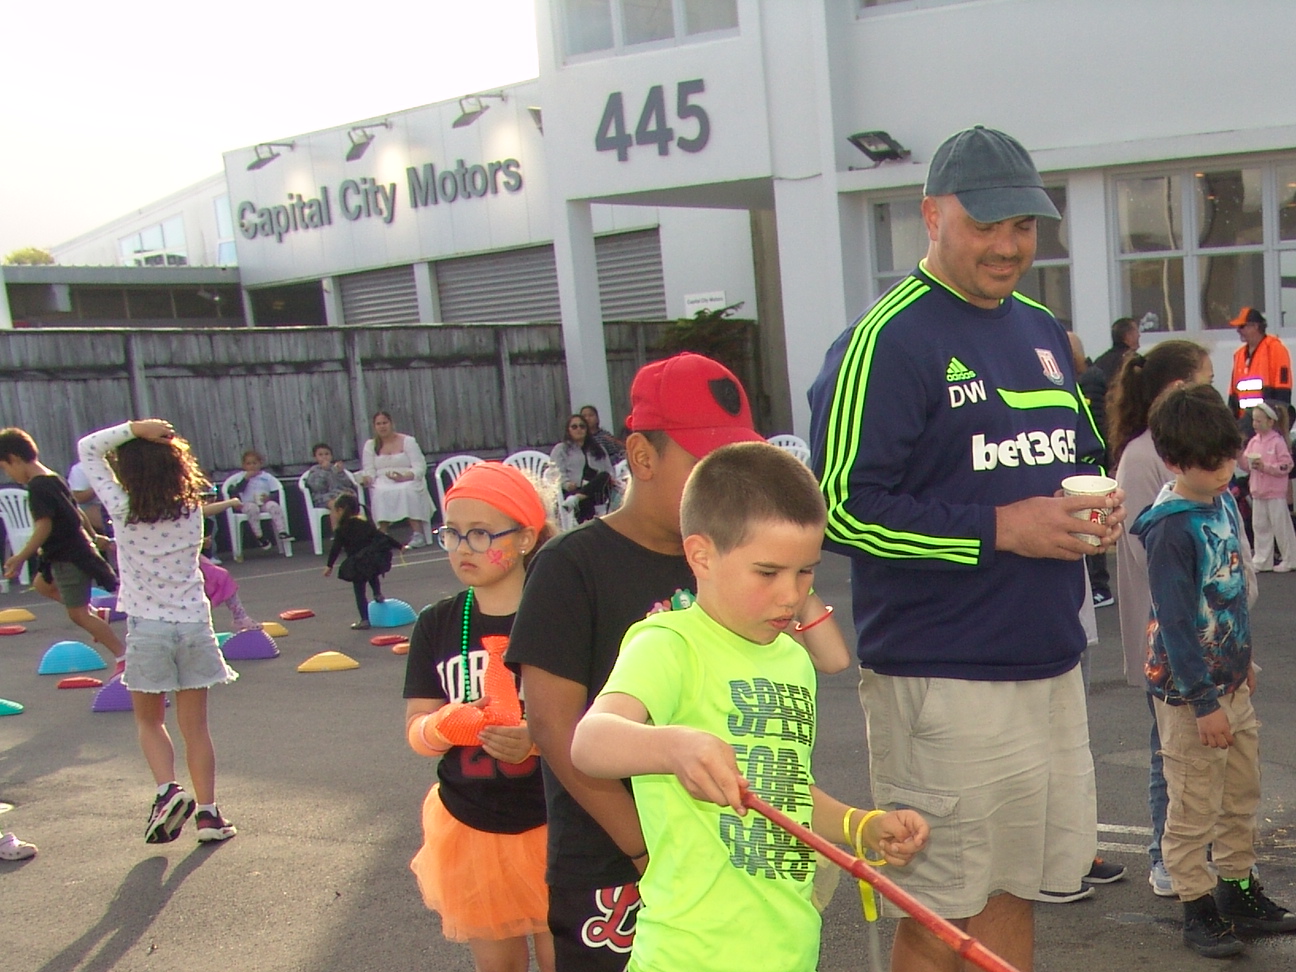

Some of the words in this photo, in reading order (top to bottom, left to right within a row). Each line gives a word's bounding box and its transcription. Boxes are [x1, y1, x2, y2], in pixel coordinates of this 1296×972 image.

[594, 78, 711, 162] 445
[236, 186, 332, 242] Capital
[337, 177, 397, 224] City
[406, 157, 523, 208] Motors
[946, 370, 977, 382] adidas
[948, 380, 987, 408] DW
